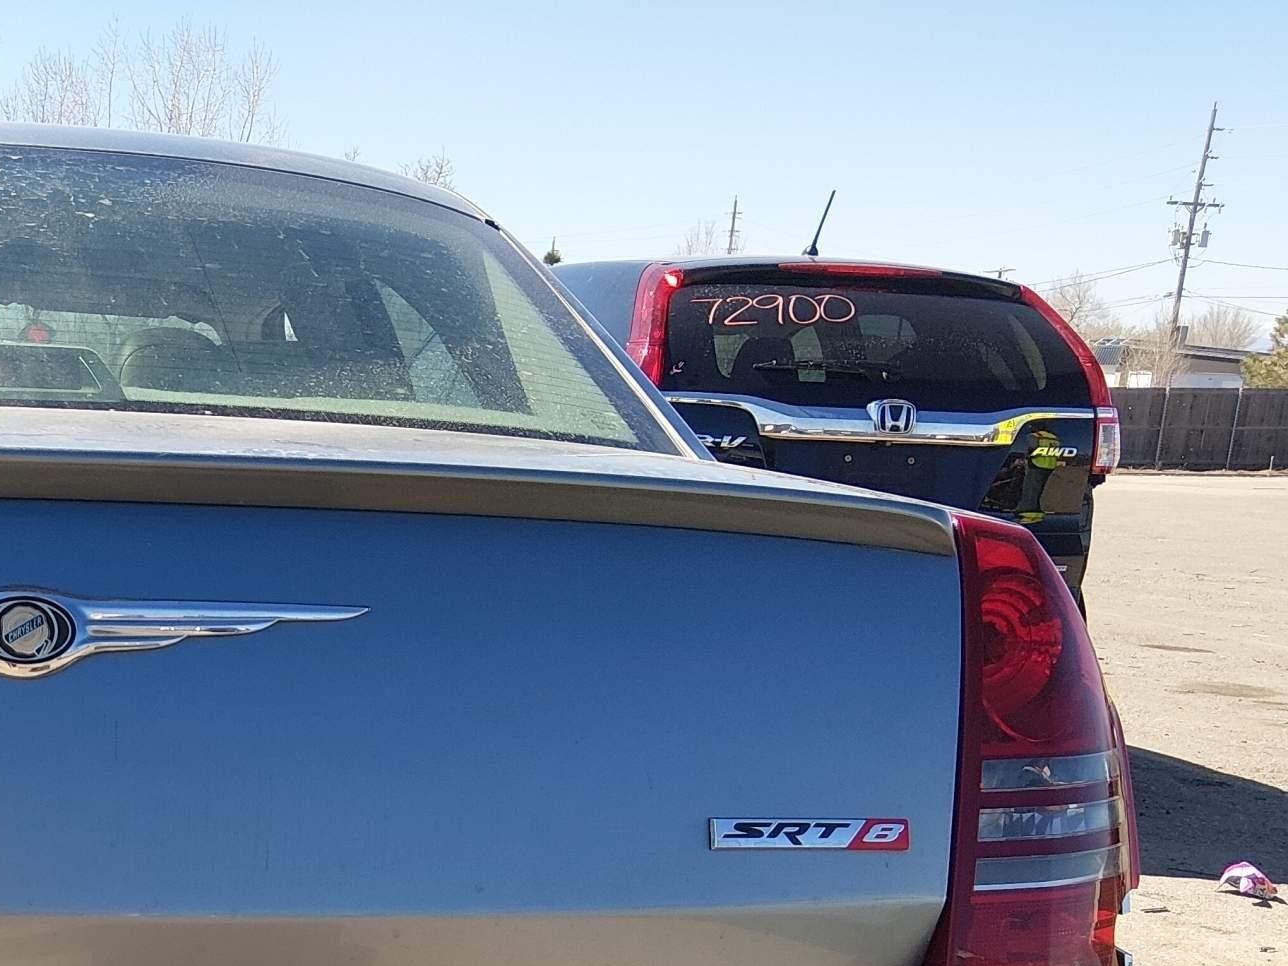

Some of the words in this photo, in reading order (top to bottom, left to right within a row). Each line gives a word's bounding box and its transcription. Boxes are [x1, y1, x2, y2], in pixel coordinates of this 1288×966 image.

[690, 294, 856, 325] 72900
[1031, 447, 1078, 457] AWD
[8, 616, 43, 643] CHRYSLER
